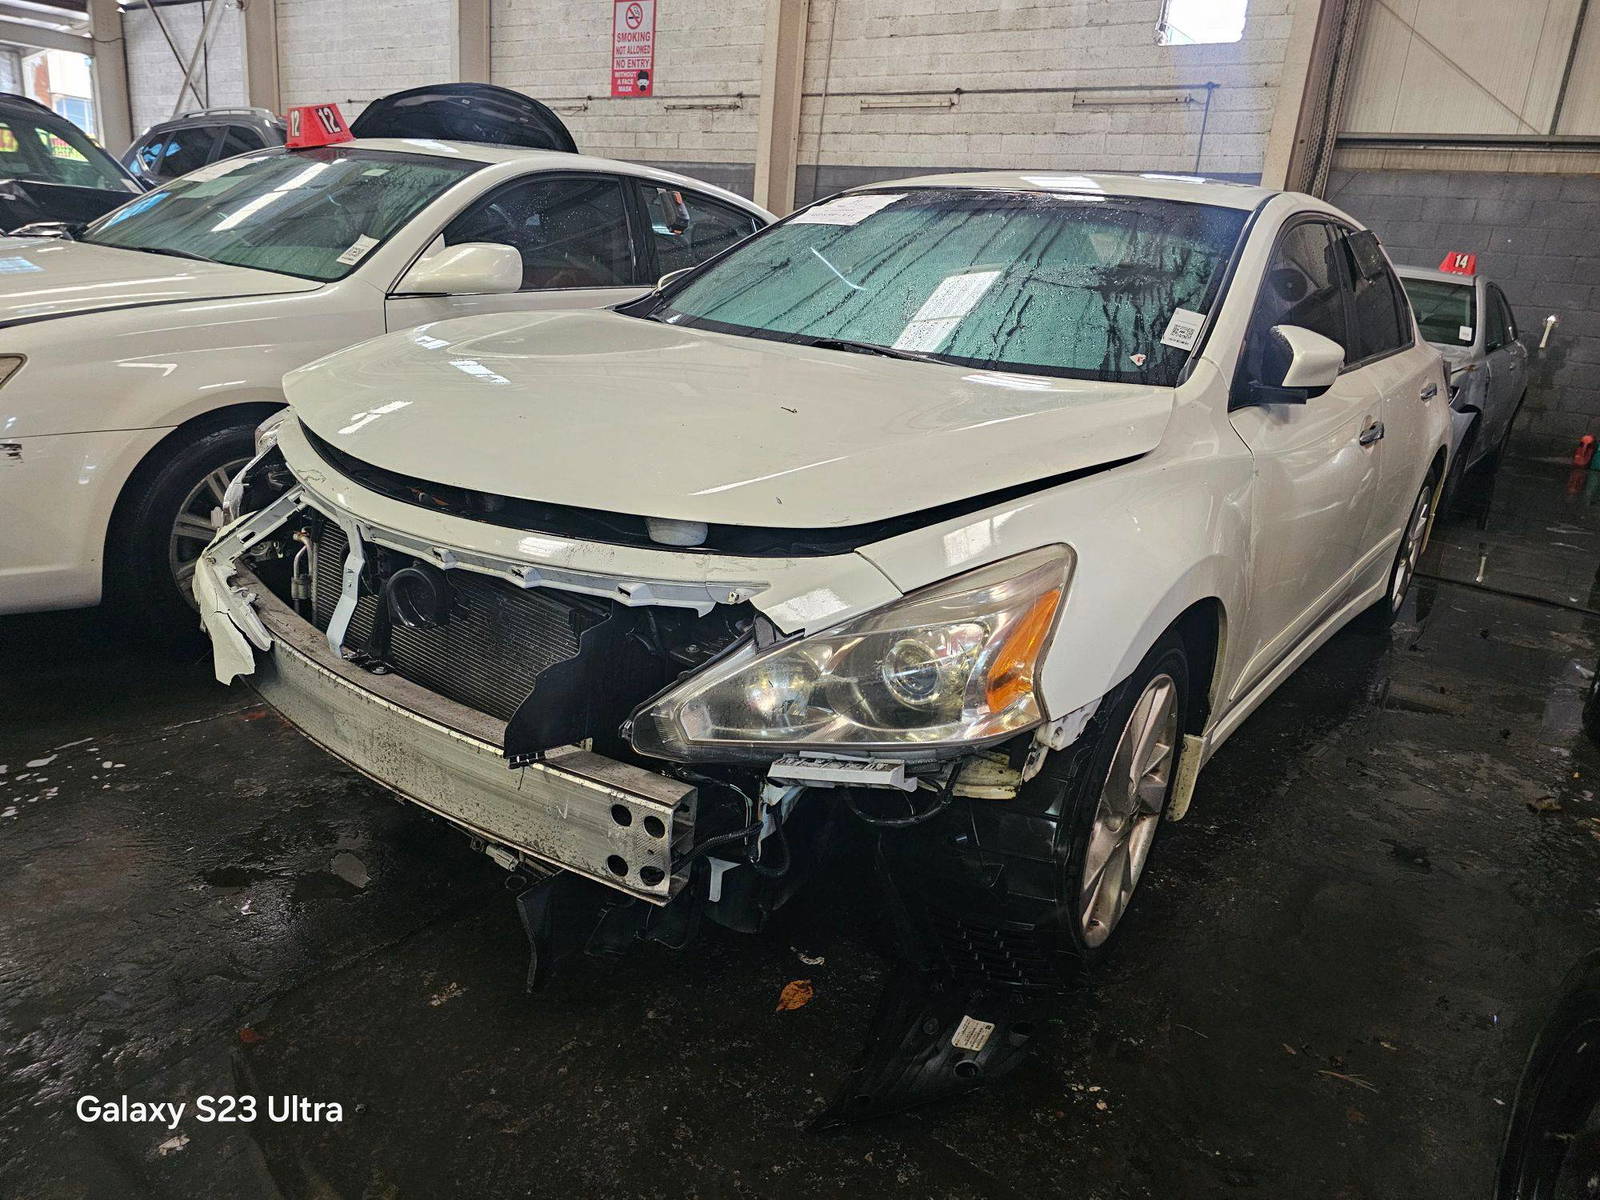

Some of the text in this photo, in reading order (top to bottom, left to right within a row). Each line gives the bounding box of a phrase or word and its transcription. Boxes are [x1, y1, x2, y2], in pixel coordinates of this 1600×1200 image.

[617, 32, 651, 43] SMOKING
[616, 45, 651, 55] NOT ALLOWED
[616, 59, 650, 68] NO ENTRY
[291, 110, 300, 137] 12
[317, 107, 341, 134] 12
[1455, 254, 1469, 269] 14
